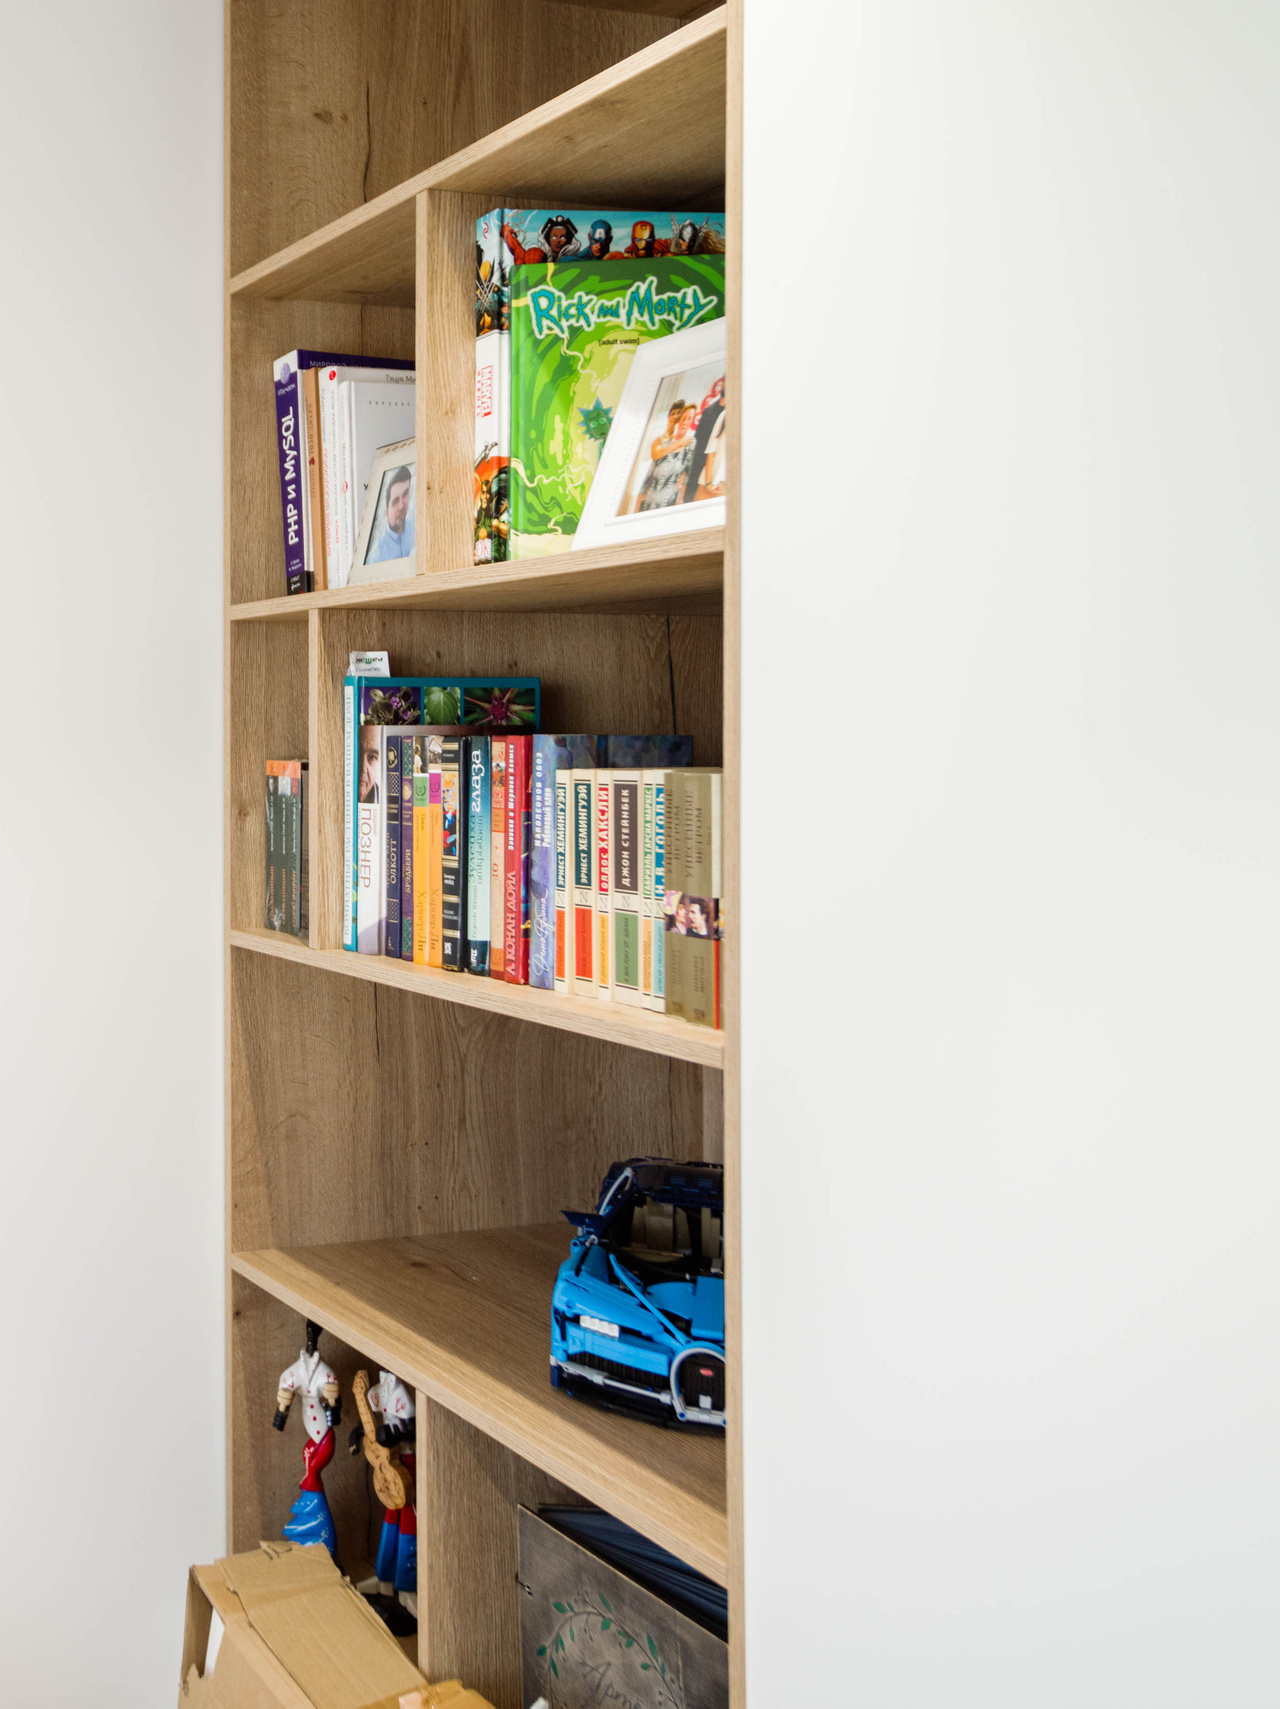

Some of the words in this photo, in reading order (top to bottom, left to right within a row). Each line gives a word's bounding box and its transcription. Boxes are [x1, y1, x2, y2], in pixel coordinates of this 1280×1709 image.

[482, 365, 492, 417] MARVEL
[281, 406, 298, 481] MySQL
[286, 484, 297, 499] и
[286, 503, 300, 545] PHP
[471, 750, 485, 812] глаза
[556, 788, 565, 854] ХЕМИНГУЭЙ
[577, 785, 588, 851] ХЕМИНГУЭЙ
[598, 787, 609, 849] ХАКСЛИ
[621, 789, 630, 847] СТЕЙНБЕК
[655, 793, 665, 853] ГОГОЛЬ
[360, 808, 371, 888] ПОЗНЕР
[580, 853, 588, 884] ЭРНЕСТ
[621, 851, 631, 886] ДЖОН
[416, 891, 426, 931] Харпер
[430, 888, 438, 929] Харпер
[506, 870, 516, 911] ДОЙЛ
[418, 934, 426, 951] Ли
[431, 933, 438, 950] Ли
[506, 913, 516, 961] КОНАН
